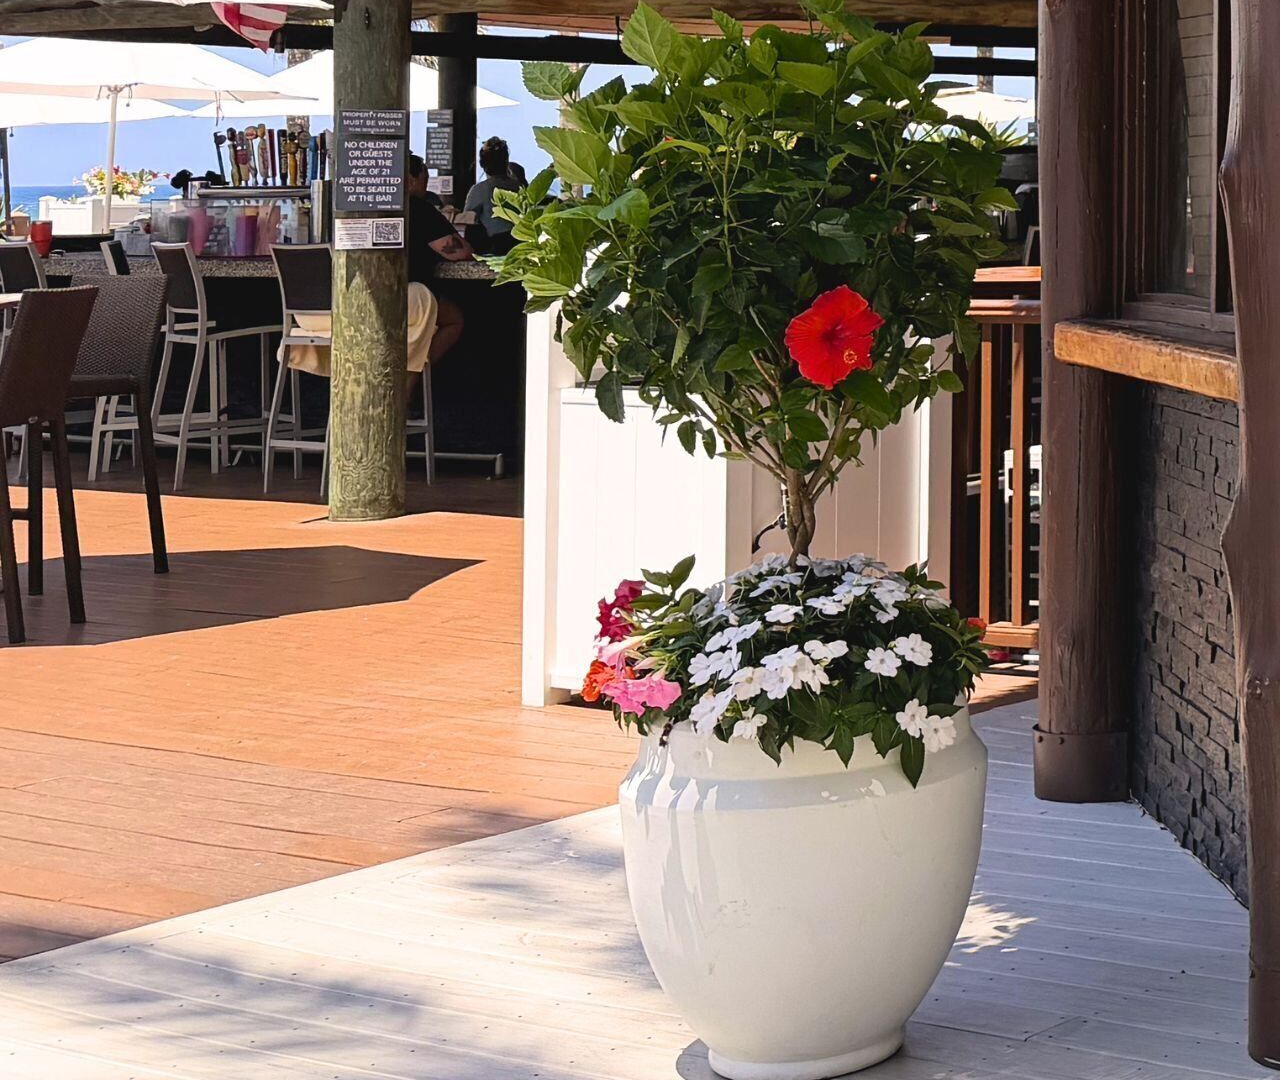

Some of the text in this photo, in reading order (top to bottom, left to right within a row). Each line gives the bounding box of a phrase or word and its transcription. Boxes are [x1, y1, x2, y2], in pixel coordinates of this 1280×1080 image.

[344, 141, 398, 149] NO CHILDREN
[348, 150, 393, 158] OR GUESTS
[348, 159, 393, 167] UNDER THE
